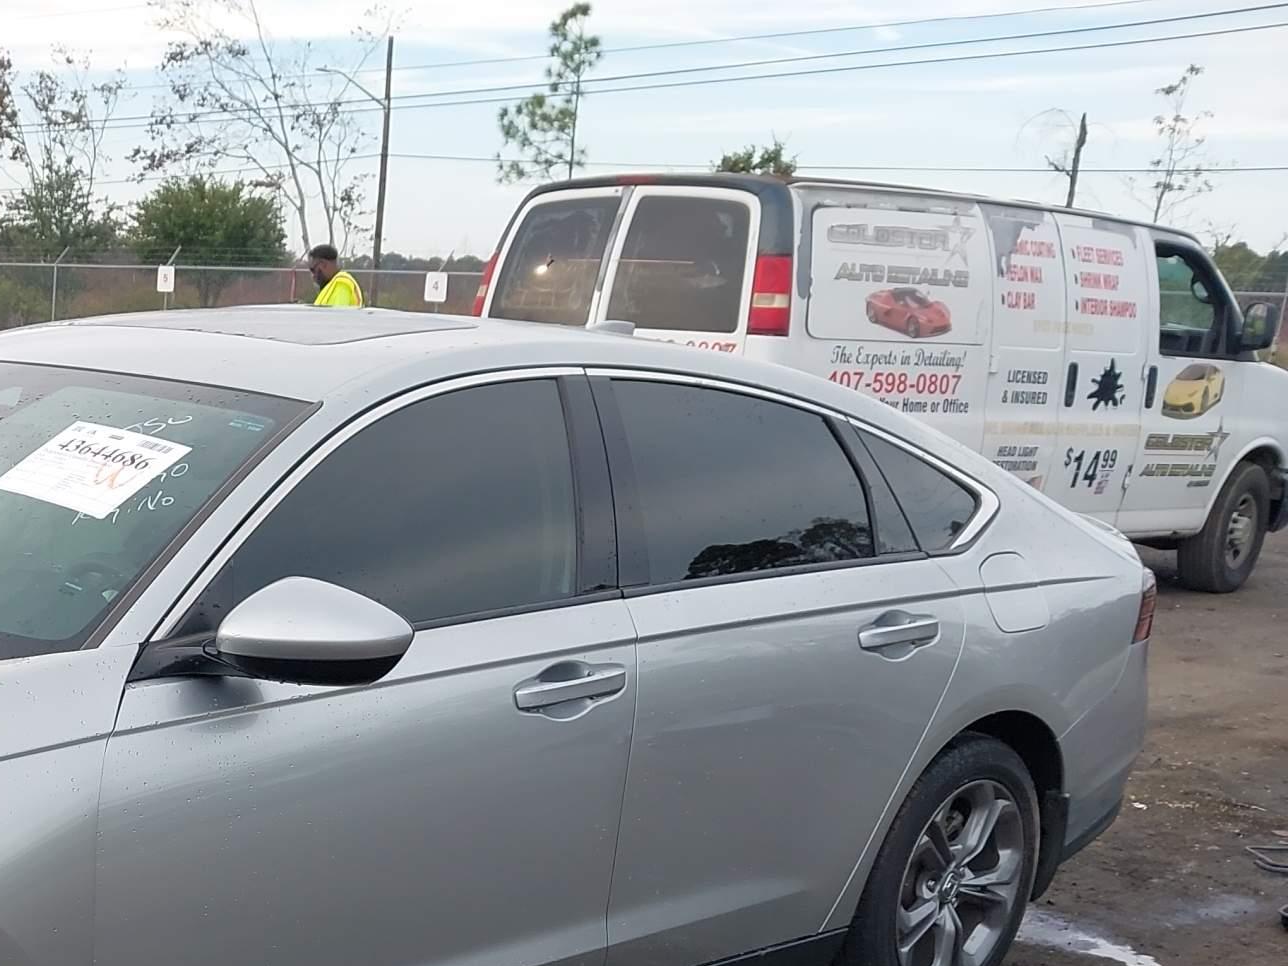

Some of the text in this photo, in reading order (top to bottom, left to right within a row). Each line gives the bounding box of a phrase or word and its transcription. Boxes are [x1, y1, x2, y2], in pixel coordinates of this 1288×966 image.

[833, 262, 885, 282] AUTO
[432, 280, 439, 291] 4
[831, 345, 967, 372] The Experts in Detailing!
[1007, 369, 1048, 384] LICENSED
[1001, 389, 1048, 405] & INSURED
[903, 397, 928, 413] Home
[931, 401, 940, 413] or
[942, 398, 969, 414] Office
[58, 438, 158, 470] 43644686
[997, 446, 1039, 457] HEAD LIGHT
